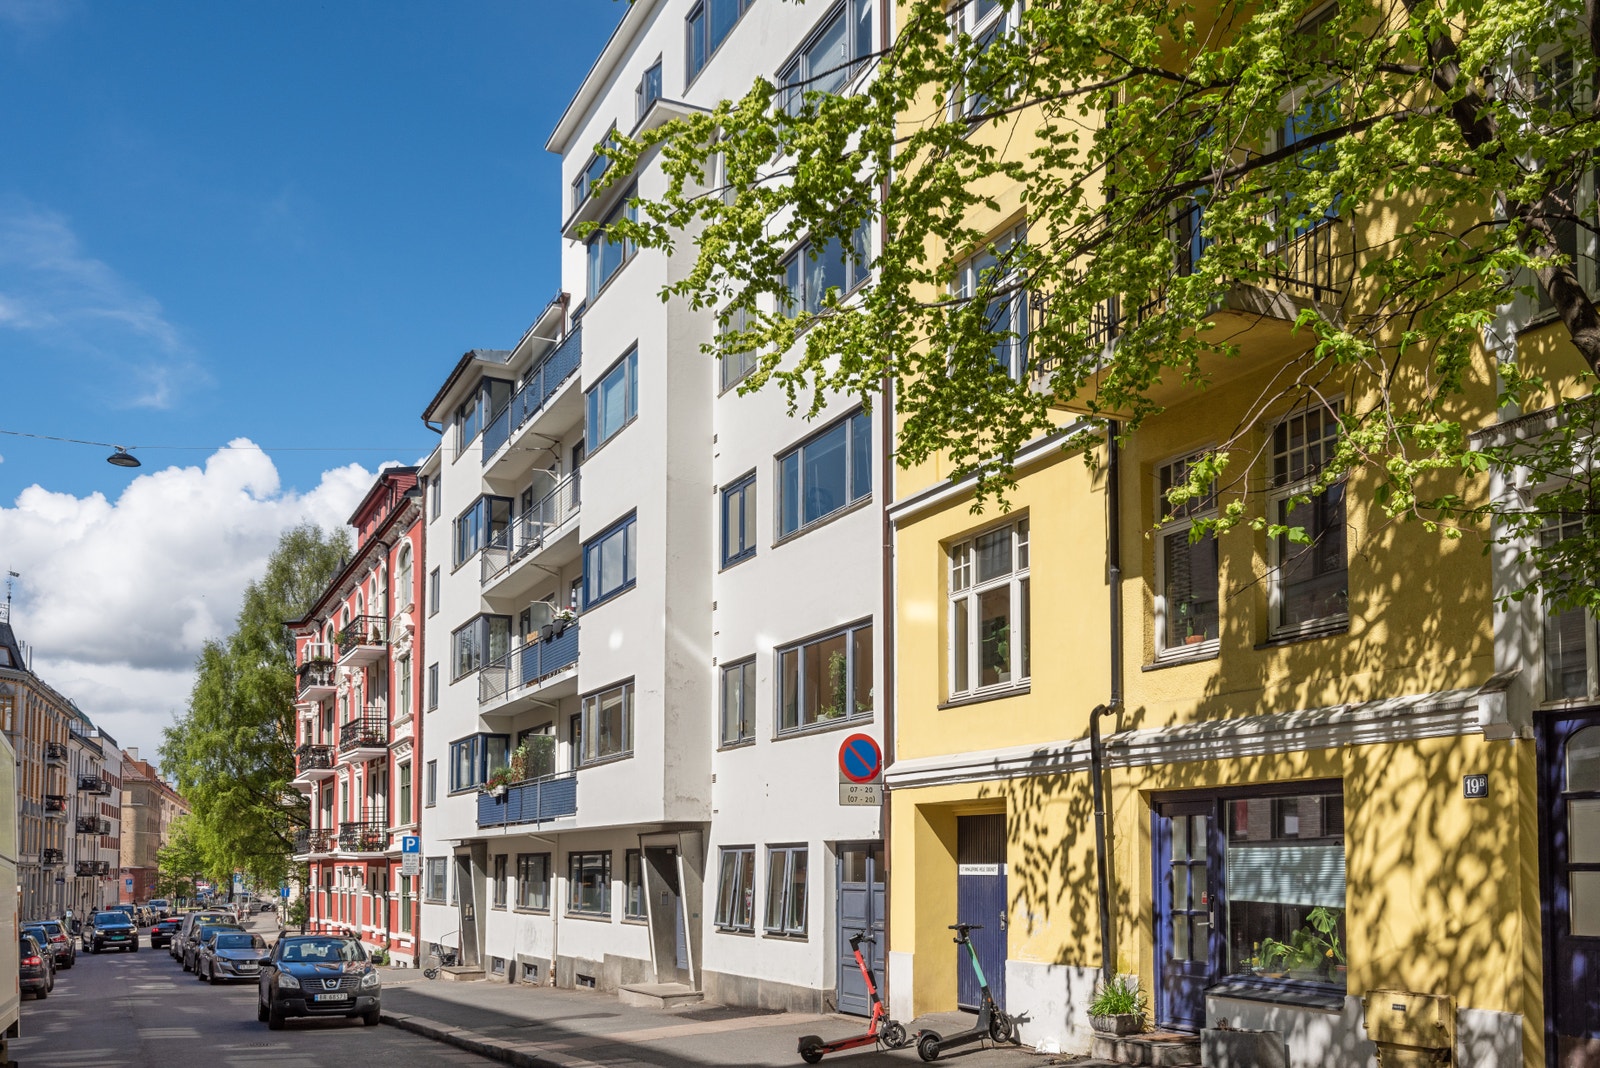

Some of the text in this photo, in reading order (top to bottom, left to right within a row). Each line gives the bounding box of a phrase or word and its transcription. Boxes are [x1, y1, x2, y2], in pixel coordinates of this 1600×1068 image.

[847, 795, 858, 803] (07
[864, 795, 876, 803] 20)
[406, 838, 416, 851] P
